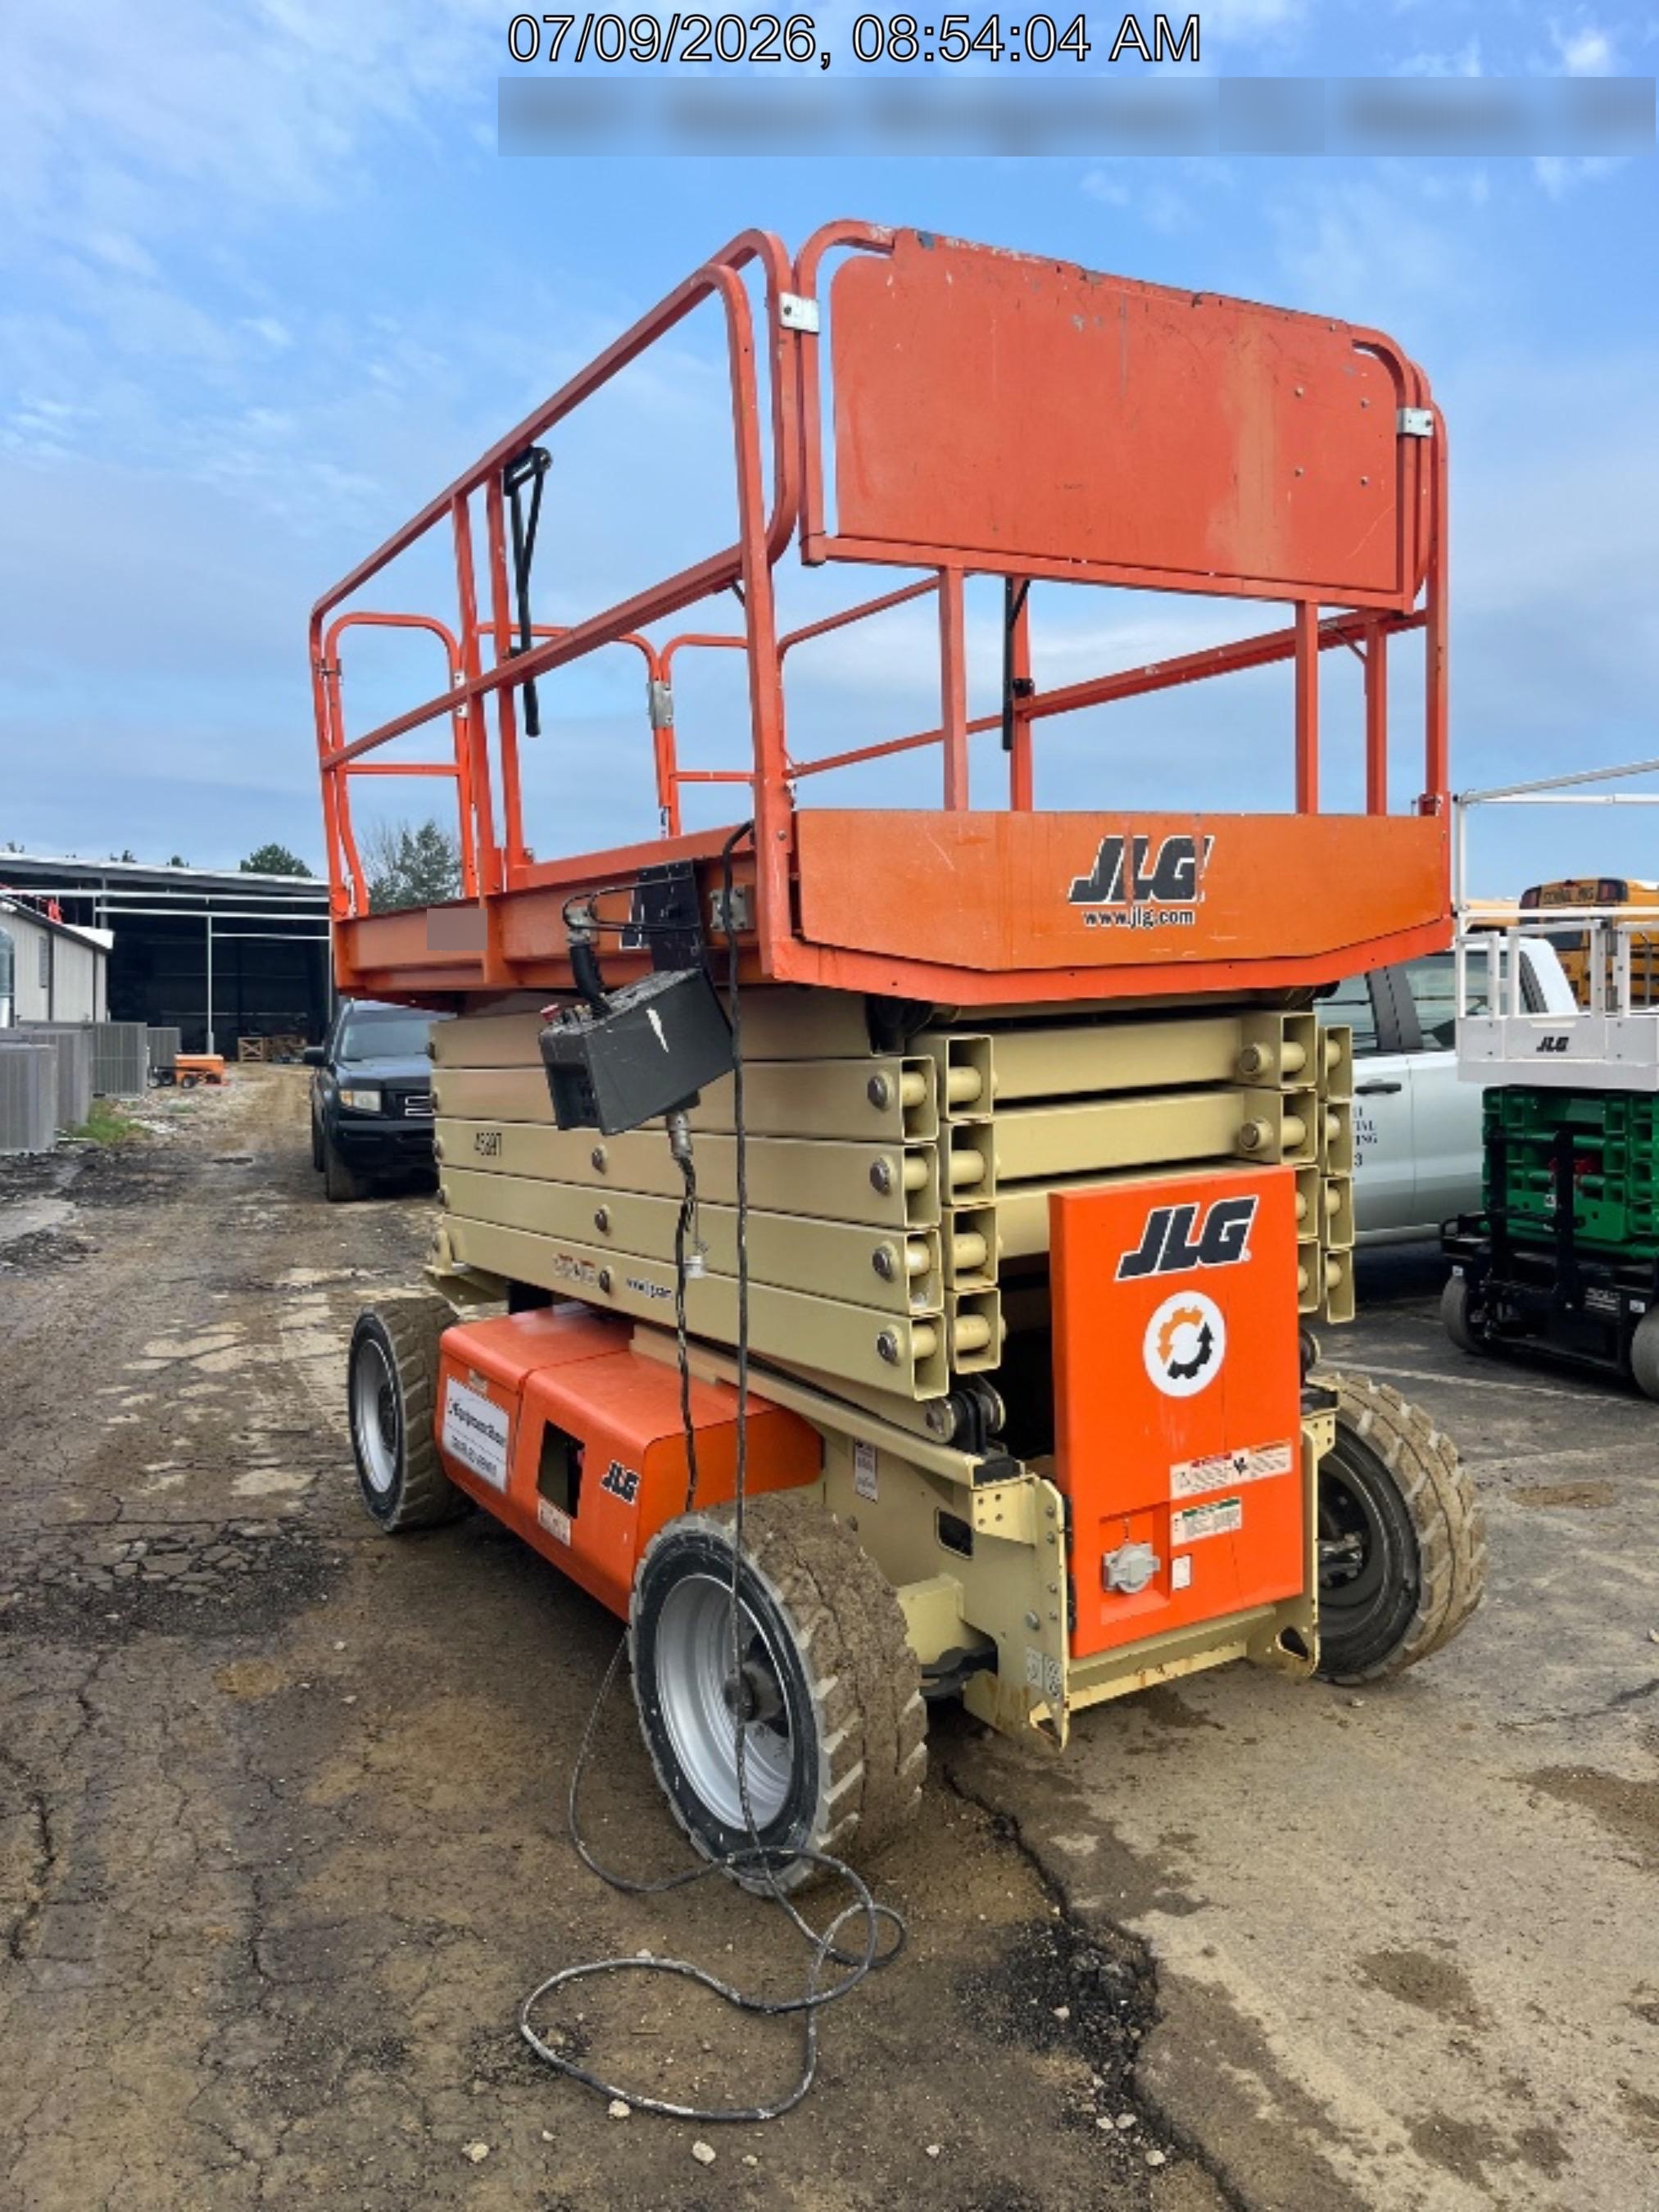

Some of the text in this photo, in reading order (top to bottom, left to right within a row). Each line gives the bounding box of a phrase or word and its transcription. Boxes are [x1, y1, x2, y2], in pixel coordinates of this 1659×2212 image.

[1067, 835, 1215, 904] JLG
[1082, 906, 1195, 930] www.jlg.com
[1535, 1036, 1570, 1053] JLG
[1114, 1195, 1259, 1281] JLG
[601, 1459, 641, 1504] JLG
